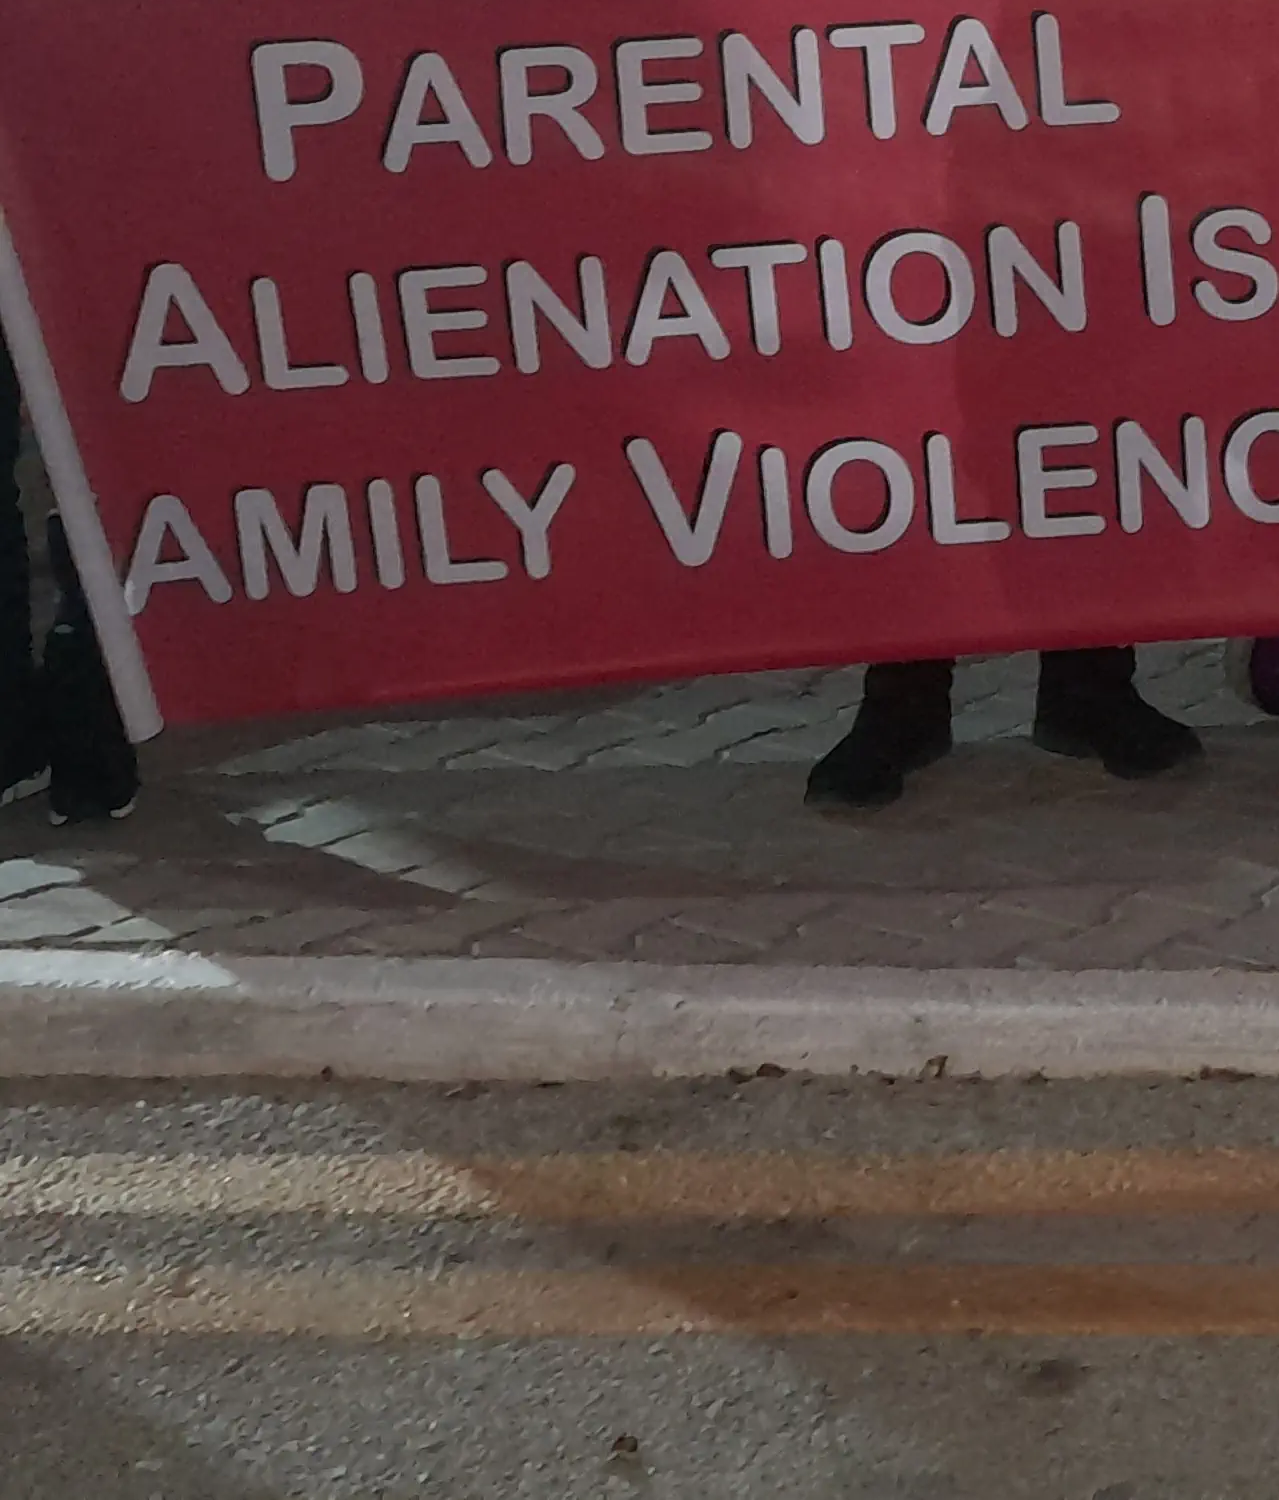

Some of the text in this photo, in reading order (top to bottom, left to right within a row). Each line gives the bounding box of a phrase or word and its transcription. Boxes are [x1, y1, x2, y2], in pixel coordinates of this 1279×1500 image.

[250, 11, 1122, 183] PARENTAL
[119, 220, 1088, 402] ALIENATION
[123, 462, 577, 617] AMILY
